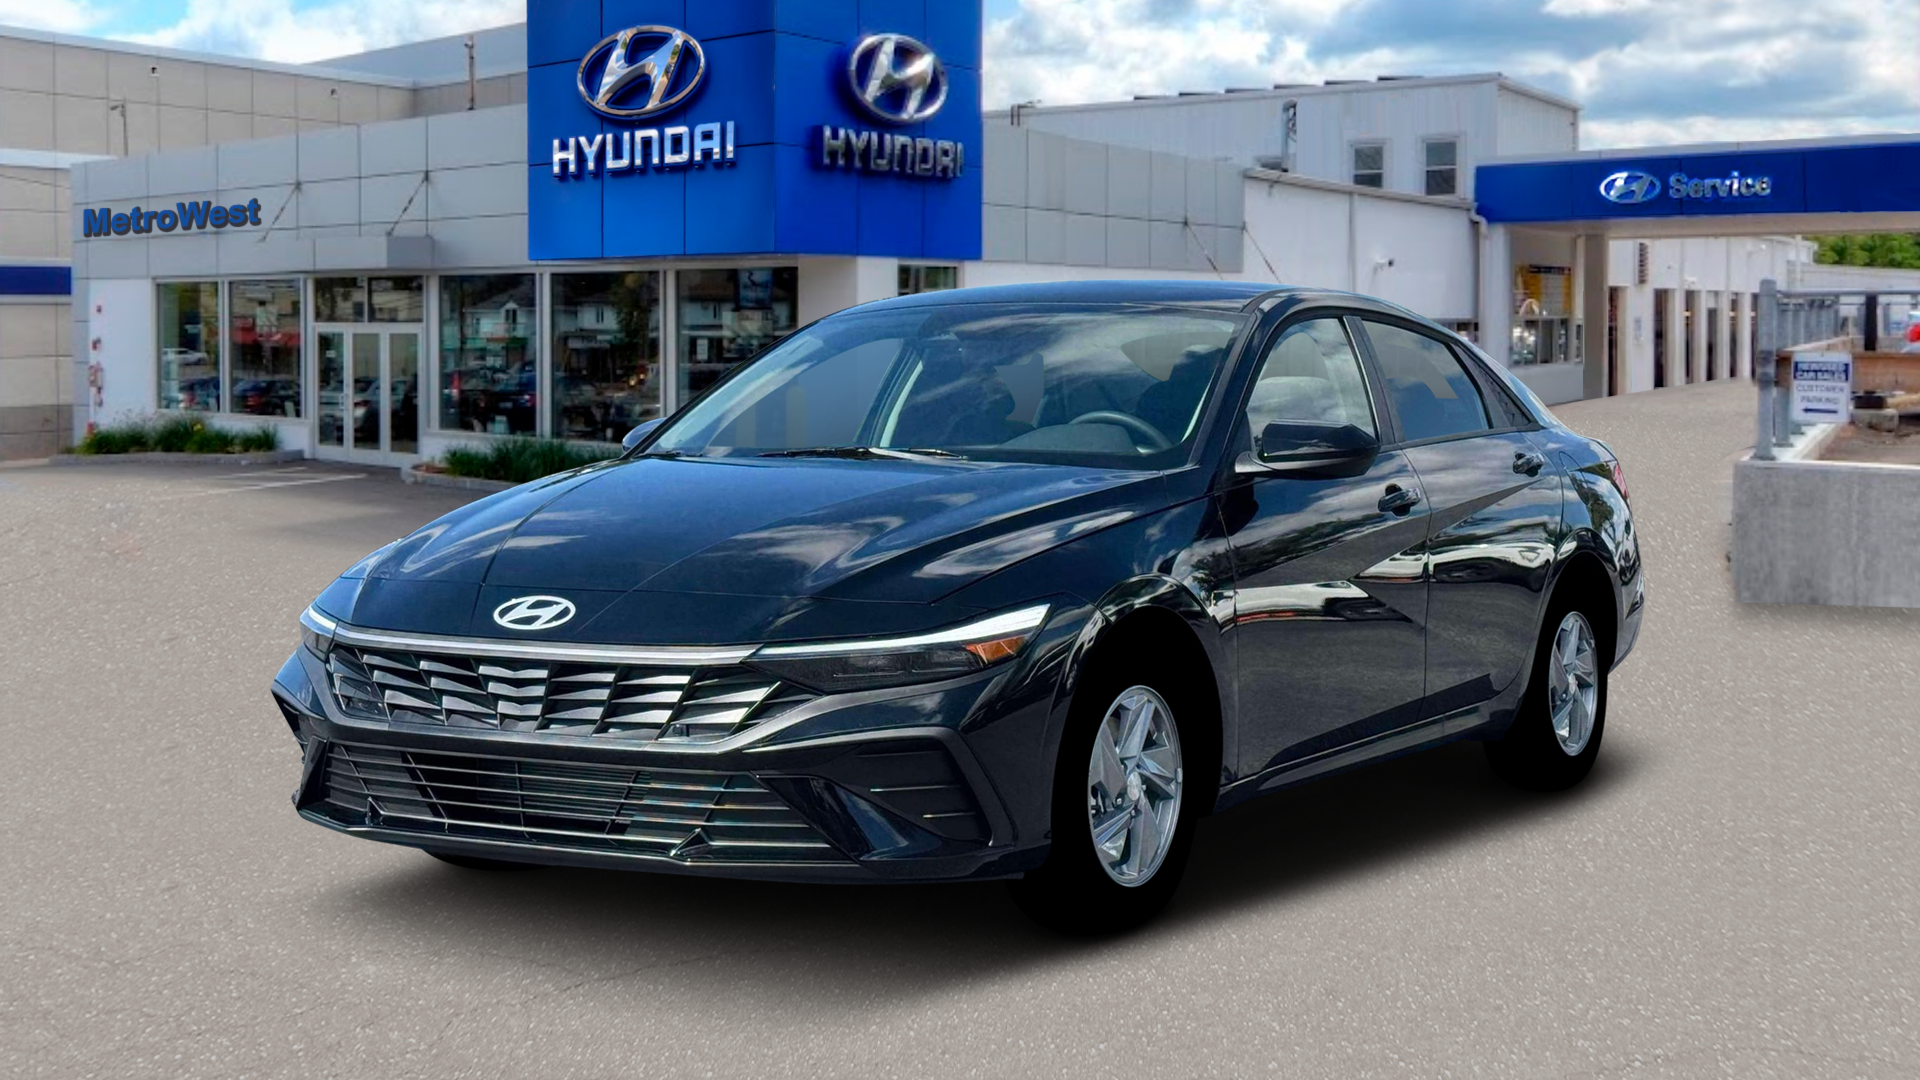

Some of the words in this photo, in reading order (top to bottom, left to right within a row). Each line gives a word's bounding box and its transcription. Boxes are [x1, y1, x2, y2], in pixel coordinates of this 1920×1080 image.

[552, 120, 736, 178] HYUNDAI
[821, 124, 965, 179] HYUNDAI
[1668, 170, 1772, 199] Service
[83, 198, 262, 237] MetroWest
[1796, 384, 1844, 393] CUSTOMER
[1800, 395, 1840, 405] PARKING
